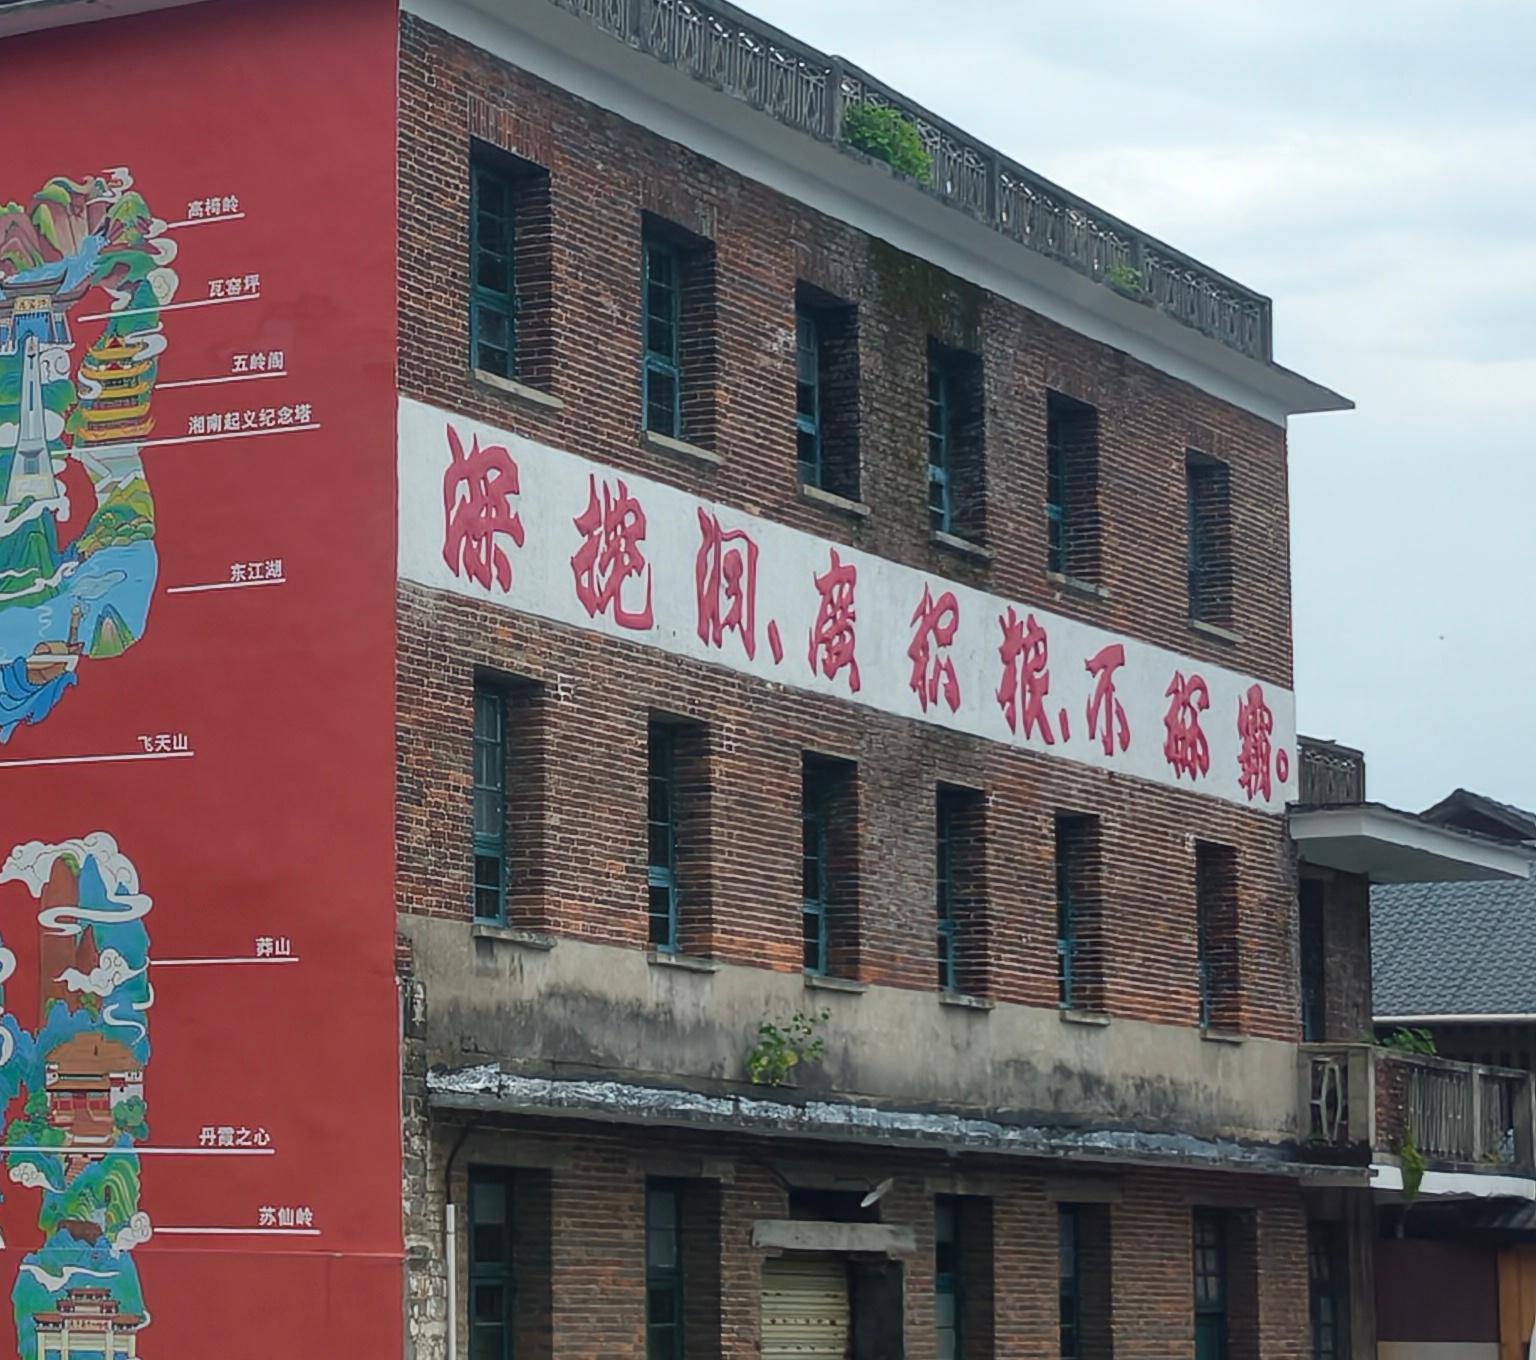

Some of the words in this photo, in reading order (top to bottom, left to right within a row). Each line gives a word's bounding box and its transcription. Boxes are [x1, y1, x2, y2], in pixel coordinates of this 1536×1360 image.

[231, 351, 284, 373] 五岭阁
[188, 403, 312, 435] 湘南起义纪念塔
[230, 559, 282, 582] 东江湖
[137, 733, 188, 752] 飞天山
[255, 936, 291, 957] 莽山
[199, 1126, 271, 1147] 丹霞之心
[258, 1206, 313, 1227] 苏仙岭
